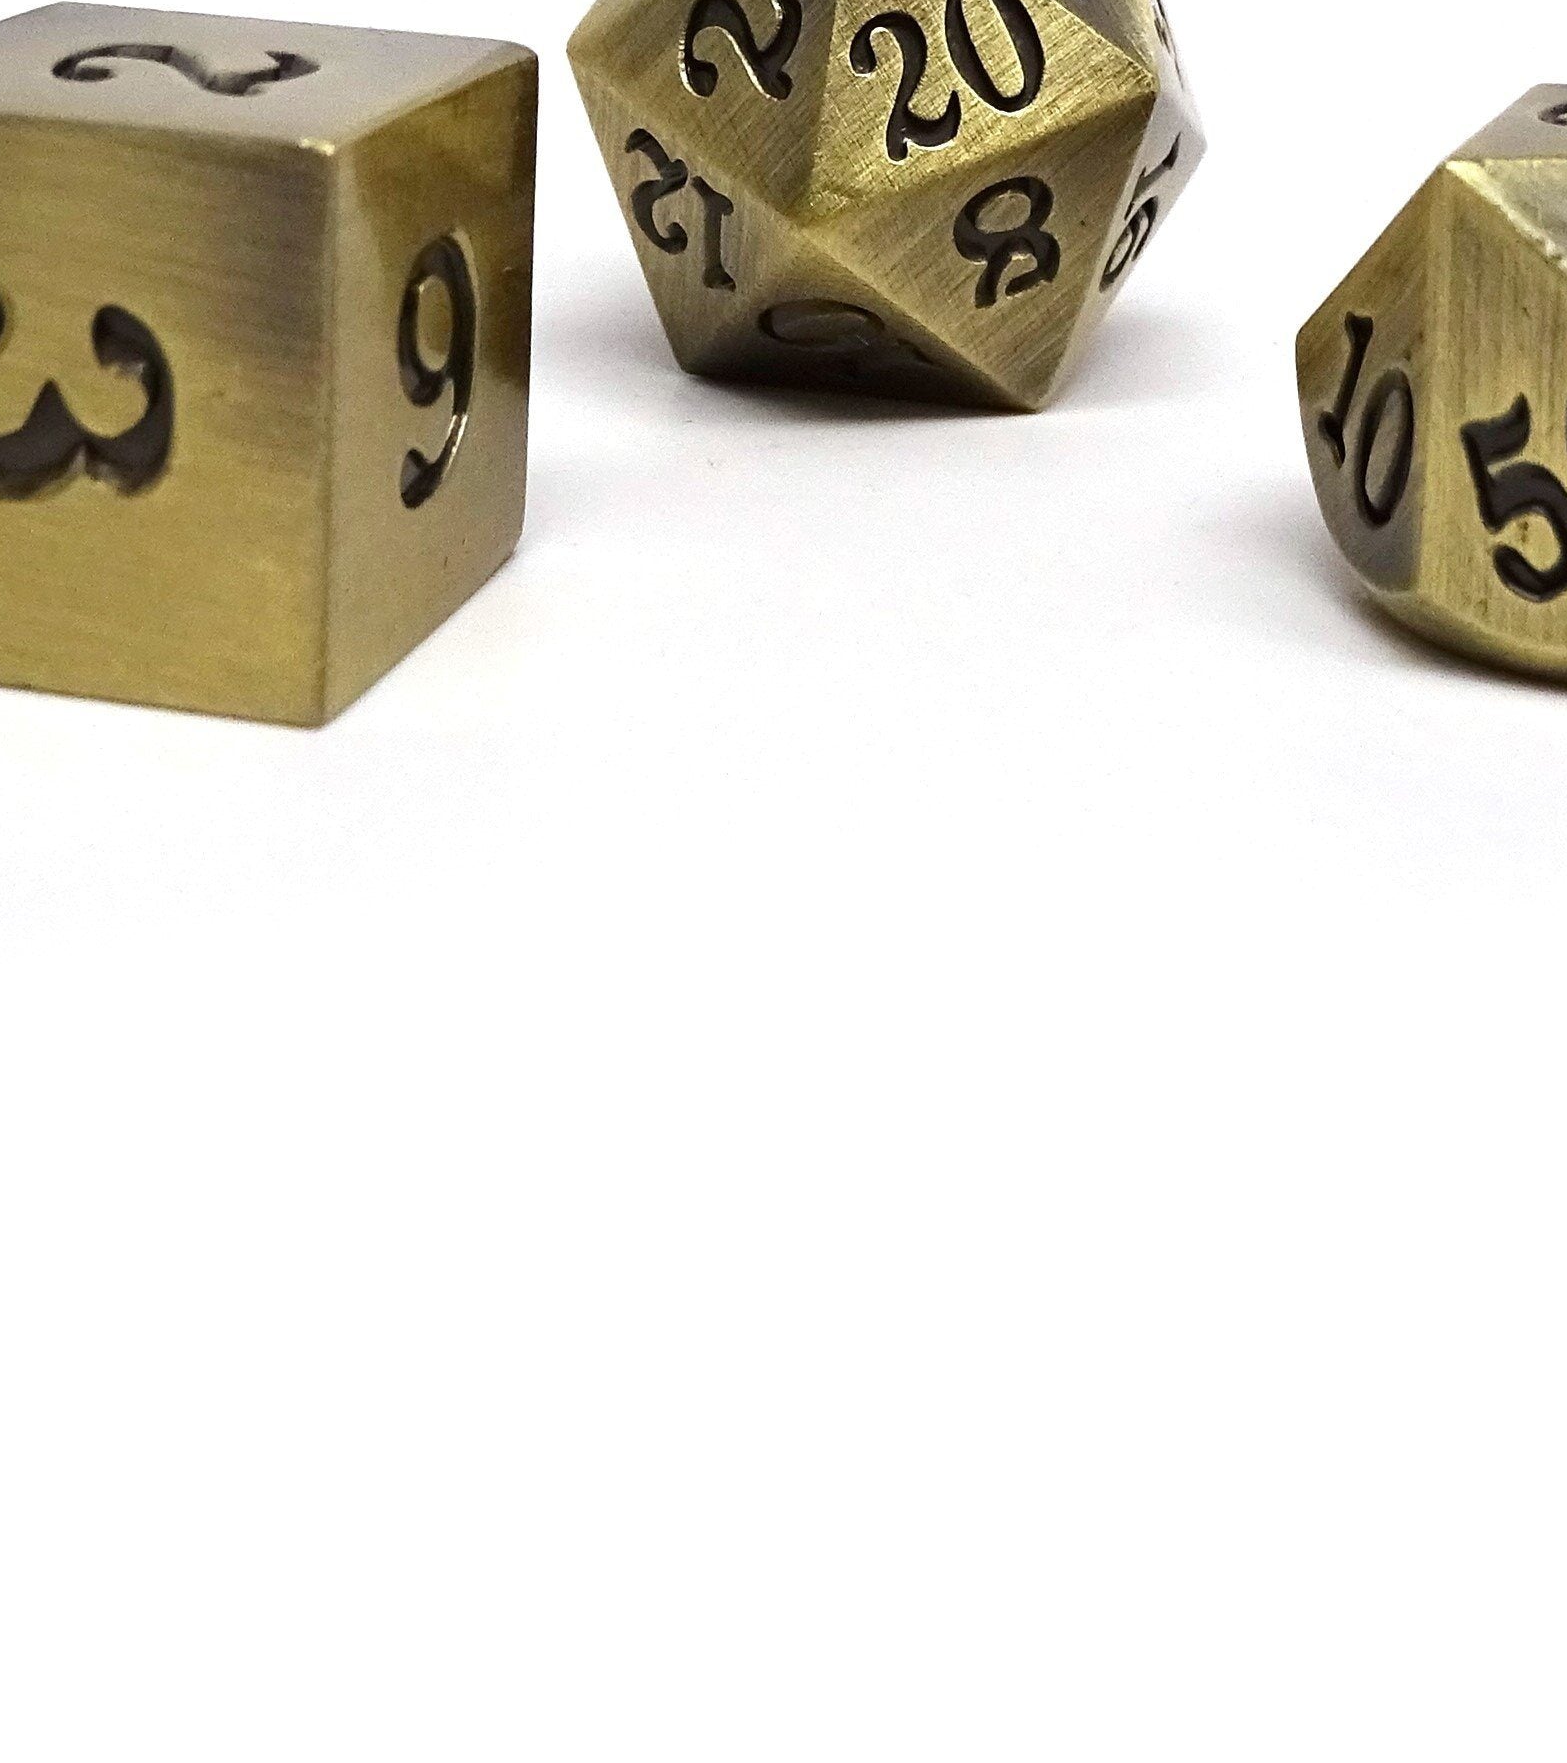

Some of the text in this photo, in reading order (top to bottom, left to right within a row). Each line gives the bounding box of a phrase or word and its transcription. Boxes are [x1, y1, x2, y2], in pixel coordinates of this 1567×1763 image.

[52, 44, 321, 97] 2
[953, 175, 1061, 309] 8
[1318, 311, 1415, 528] 10
